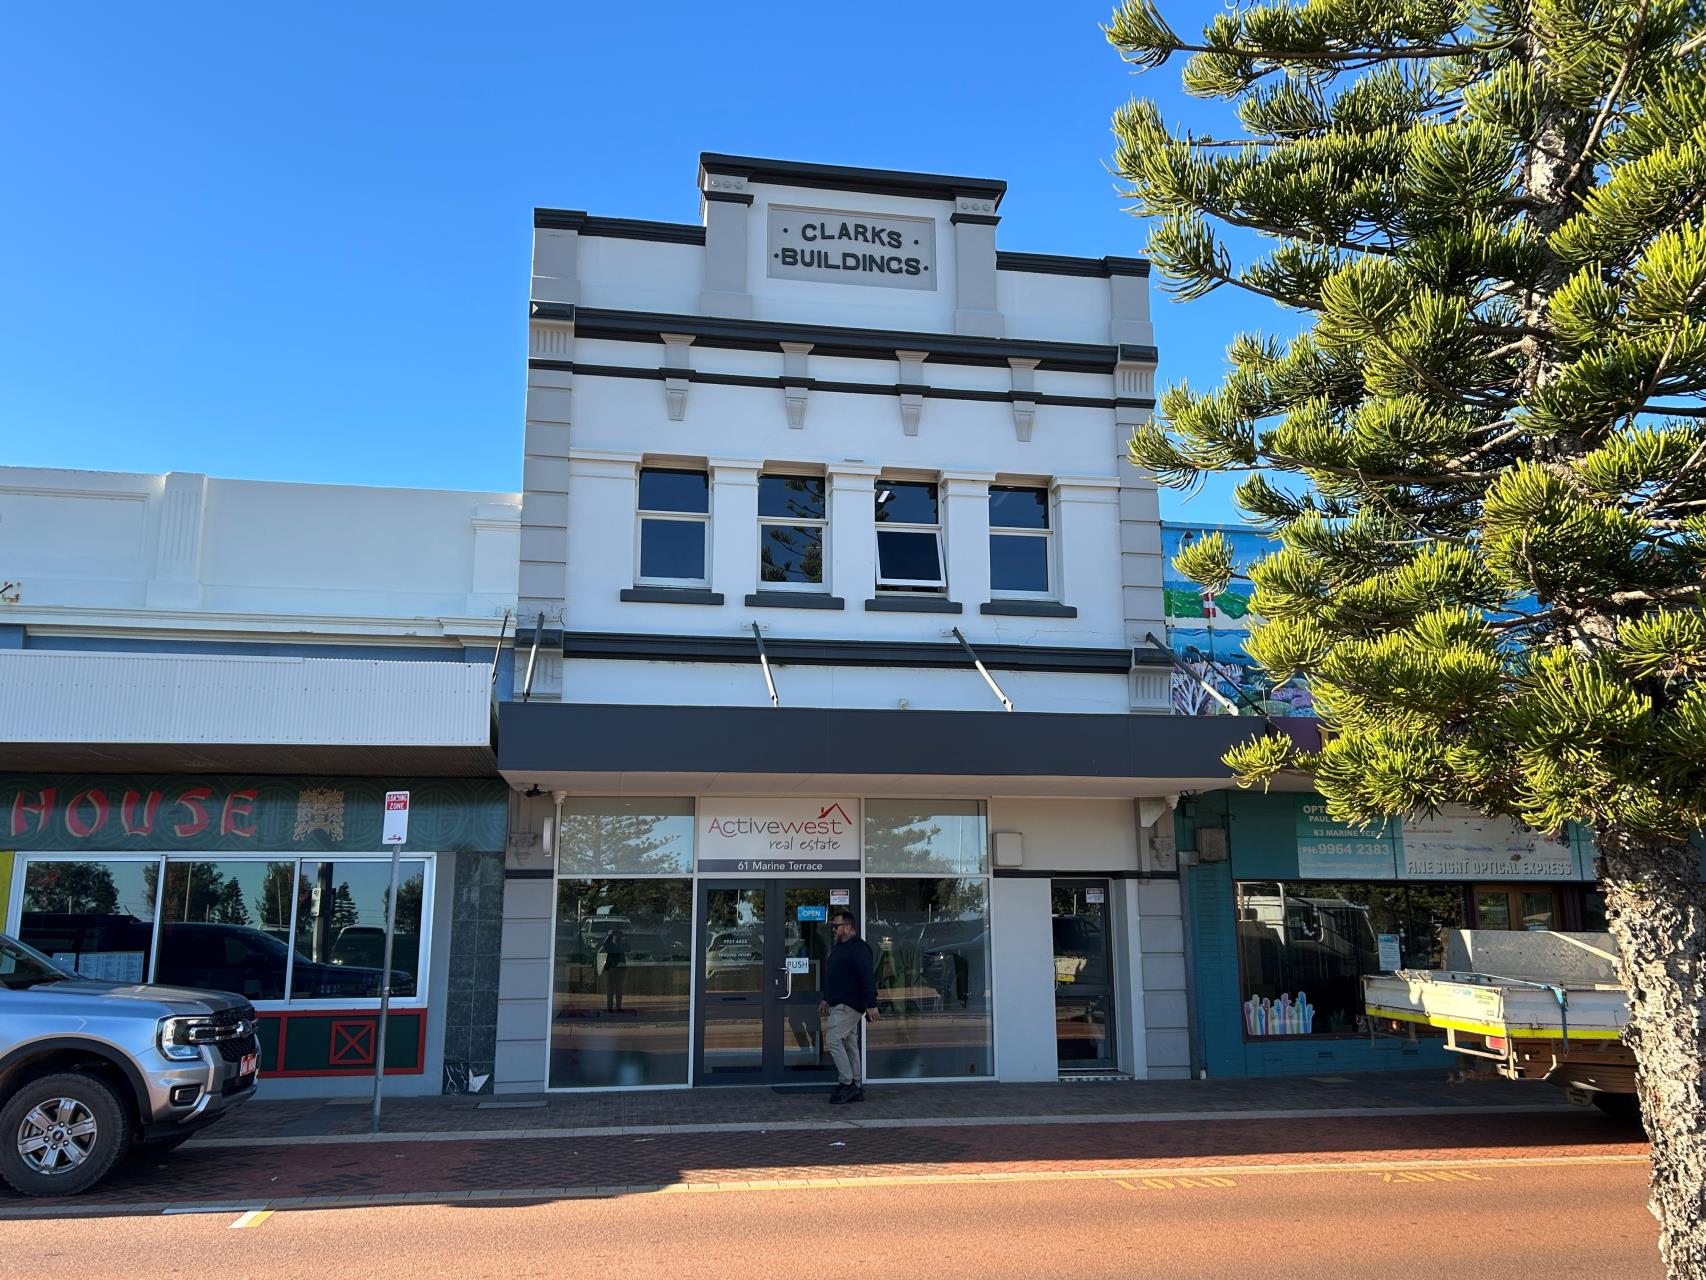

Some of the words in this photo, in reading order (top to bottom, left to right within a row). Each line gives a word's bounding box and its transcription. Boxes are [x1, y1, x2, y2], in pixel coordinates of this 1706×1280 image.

[801, 222, 903, 249] CLARKS
[781, 247, 921, 276] BUILDINGS
[10, 787, 259, 837] HOUSE
[389, 802, 405, 810] ZONE
[1309, 815, 1331, 823] PAUL
[708, 817, 843, 838] Activewest
[1313, 829, 1324, 837] 63
[1326, 829, 1358, 837] MARINE
[769, 836, 794, 851] real
[800, 837, 841, 850] estate
[1318, 843, 1353, 855] 9964
[1356, 844, 1390, 855] 2383
[737, 861, 749, 871] 61
[752, 861, 785, 871] Marine
[788, 861, 823, 871] Terrace
[1407, 861, 1434, 875] FINE
[1474, 862, 1520, 876] OPTICAL
[1523, 863, 1572, 876] EXPRESS
[786, 960, 808, 969] PUSH
[1115, 1177, 1237, 1190] LOAD
